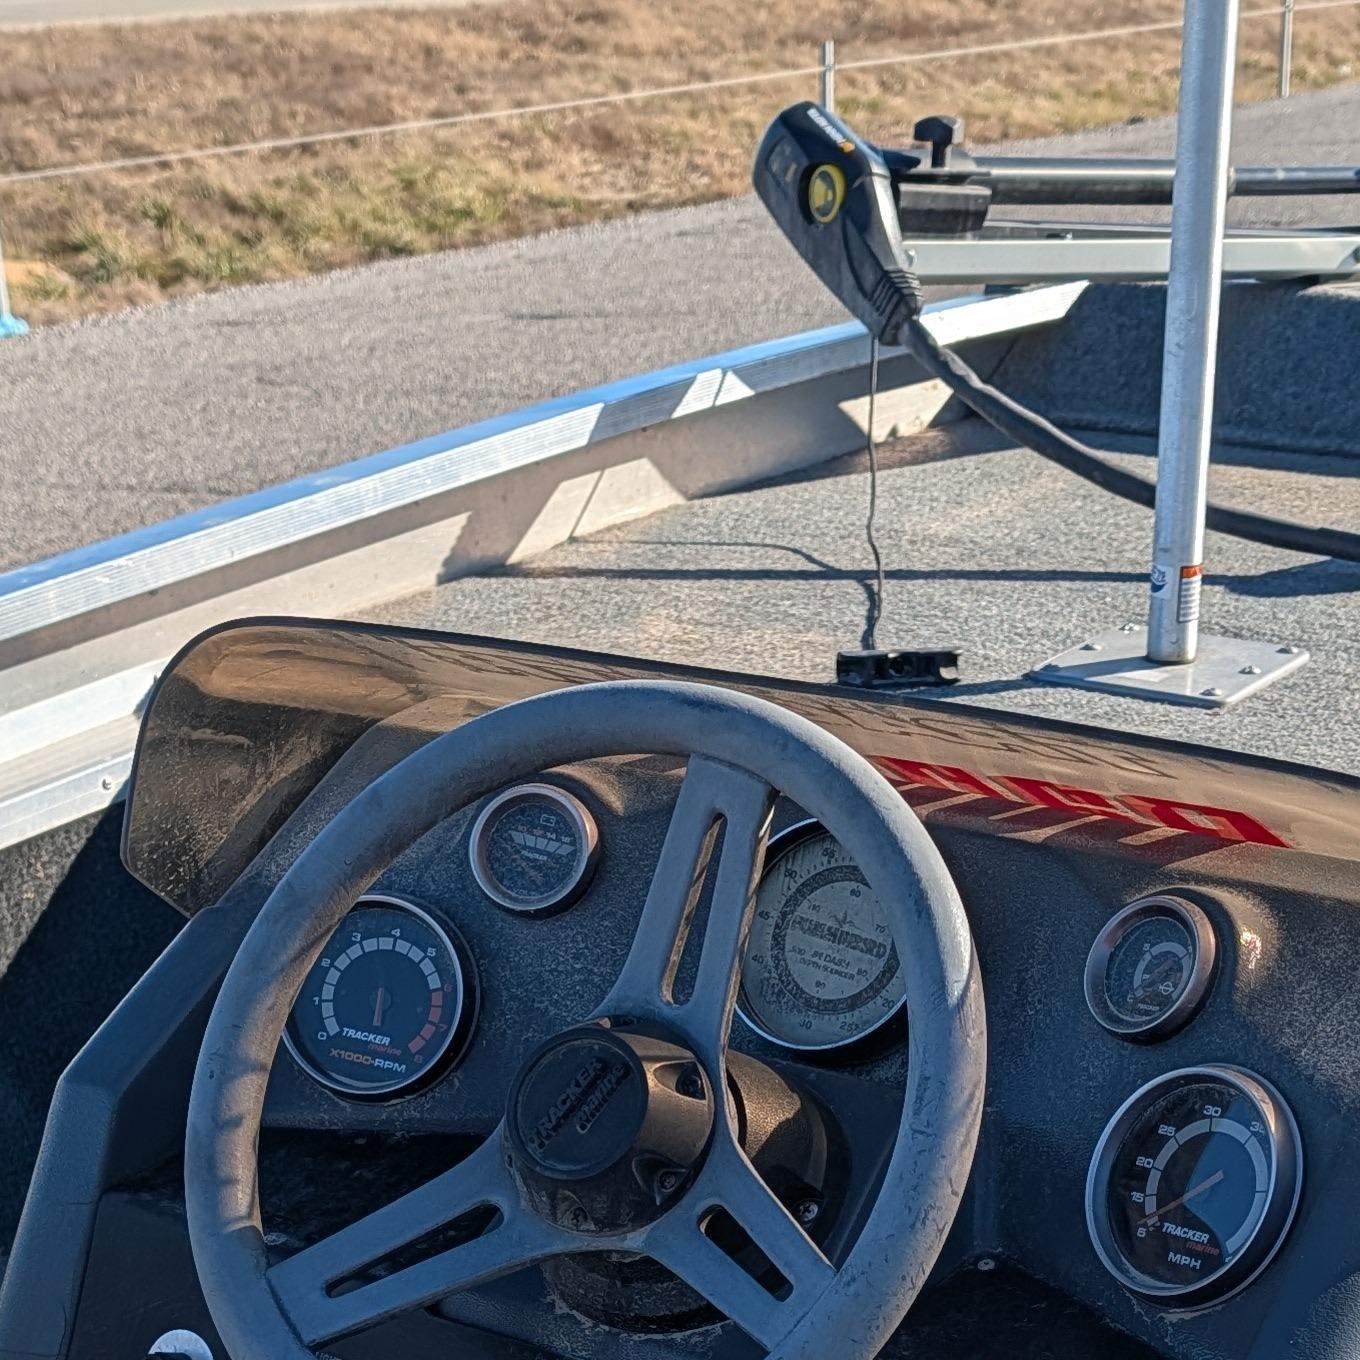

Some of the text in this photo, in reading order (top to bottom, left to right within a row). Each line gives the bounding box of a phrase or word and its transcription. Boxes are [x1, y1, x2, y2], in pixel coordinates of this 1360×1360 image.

[352, 932, 362, 942] 3
[391, 928, 401, 937] 4
[427, 947, 437, 958] 5
[321, 958, 331, 967] 2
[751, 953, 764, 965] 40
[312, 996, 320, 1005] 1
[317, 1032, 327, 1040] 0
[342, 1027, 390, 1046] TRACKER
[1203, 1105, 1221, 1116] 30
[1158, 1124, 1175, 1137] 25
[1135, 1156, 1154, 1169] 20
[1130, 1191, 1144, 1203] 15
[1162, 1222, 1210, 1243] TRACKER
[1167, 1251, 1202, 1270] MPH
